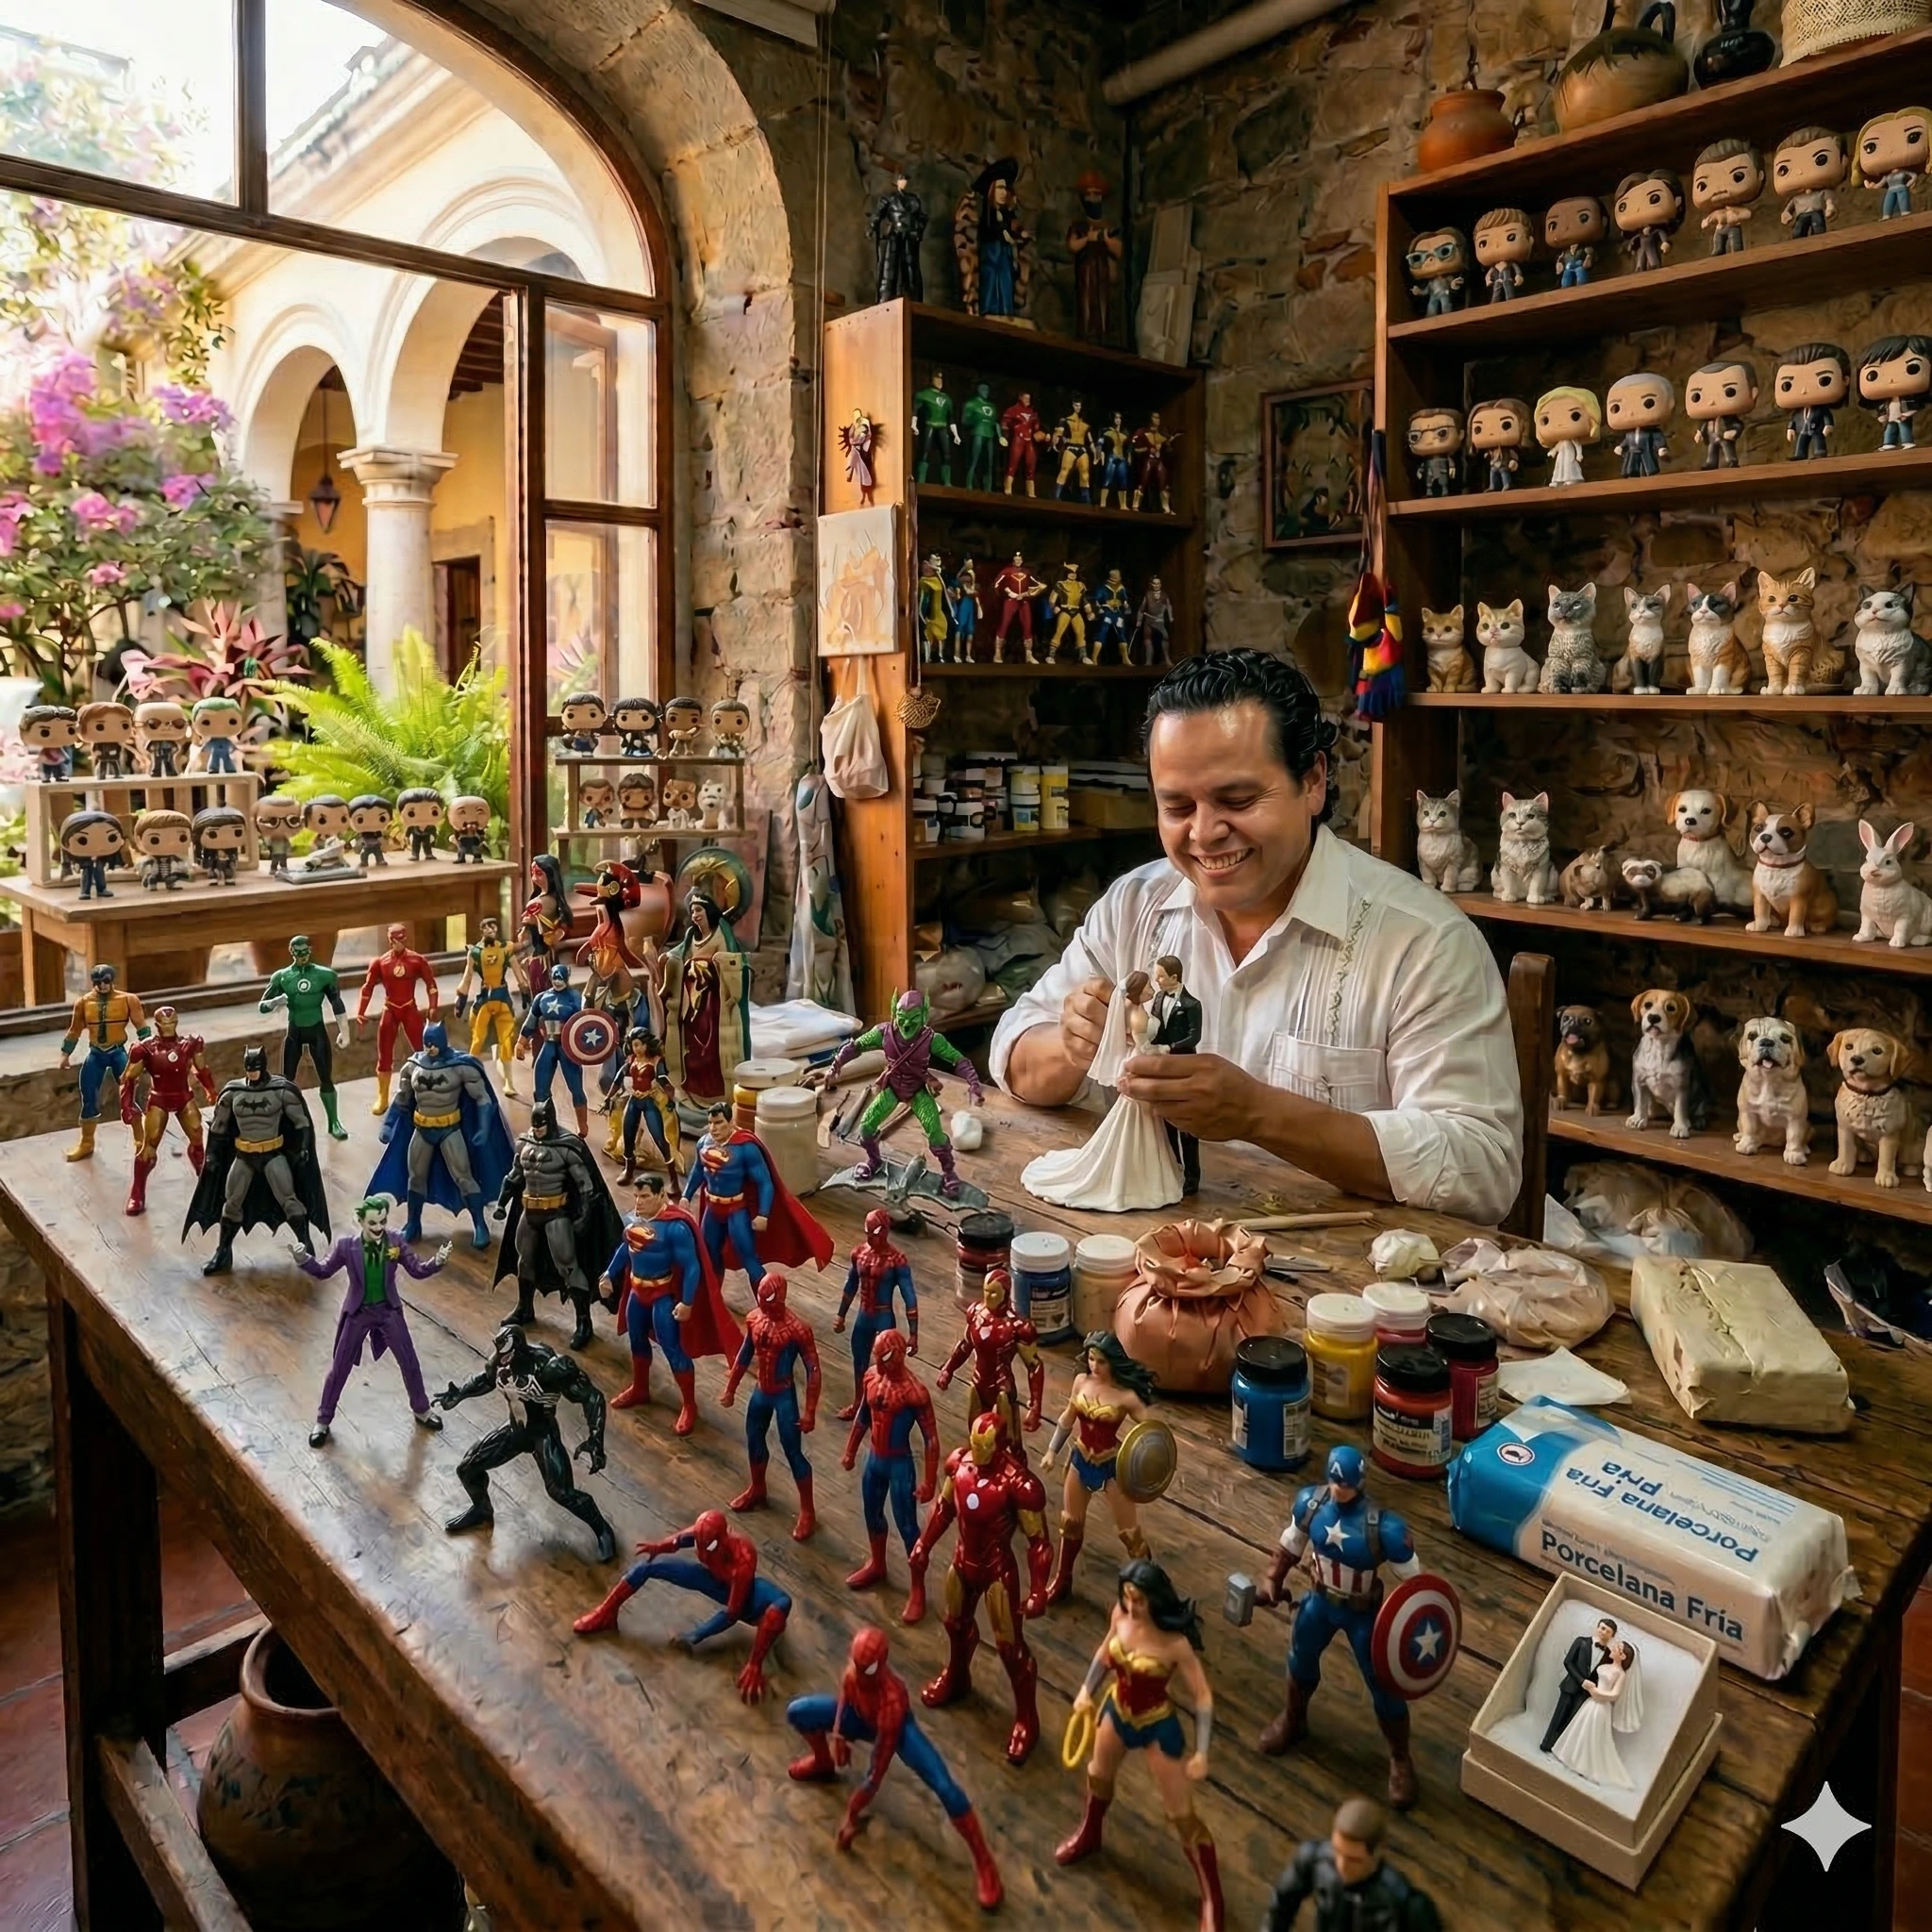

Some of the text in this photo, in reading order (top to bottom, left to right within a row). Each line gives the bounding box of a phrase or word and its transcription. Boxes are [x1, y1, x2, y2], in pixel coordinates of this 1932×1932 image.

[1621, 1491, 1759, 1562] Porcelana
[1541, 1530, 1675, 1612] Porcelana
[1687, 1595, 1743, 1641] Fría
